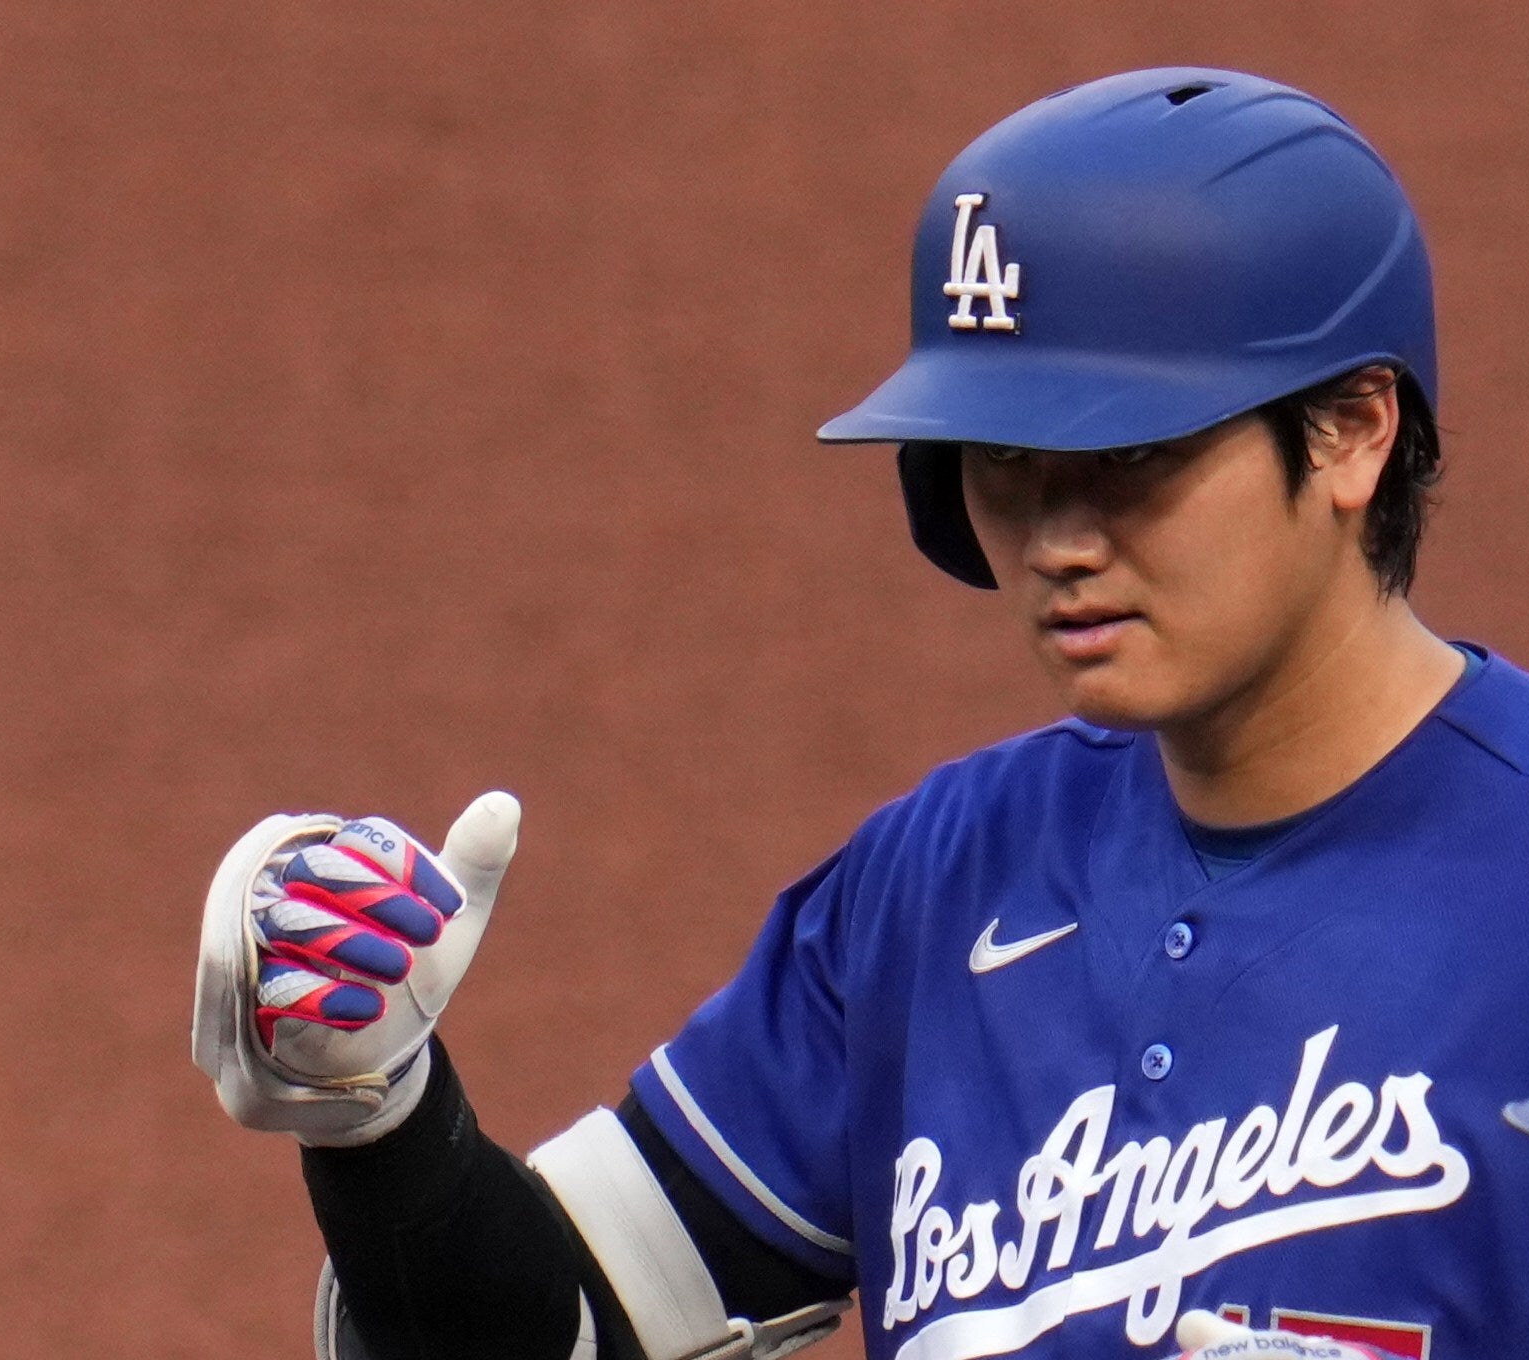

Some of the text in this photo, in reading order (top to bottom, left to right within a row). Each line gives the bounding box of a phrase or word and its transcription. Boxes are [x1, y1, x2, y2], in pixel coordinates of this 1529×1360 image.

[943, 193, 1020, 330] LA
[882, 1025, 1469, 1346] Los Angeles
[1203, 1337, 1342, 1360] new balance
